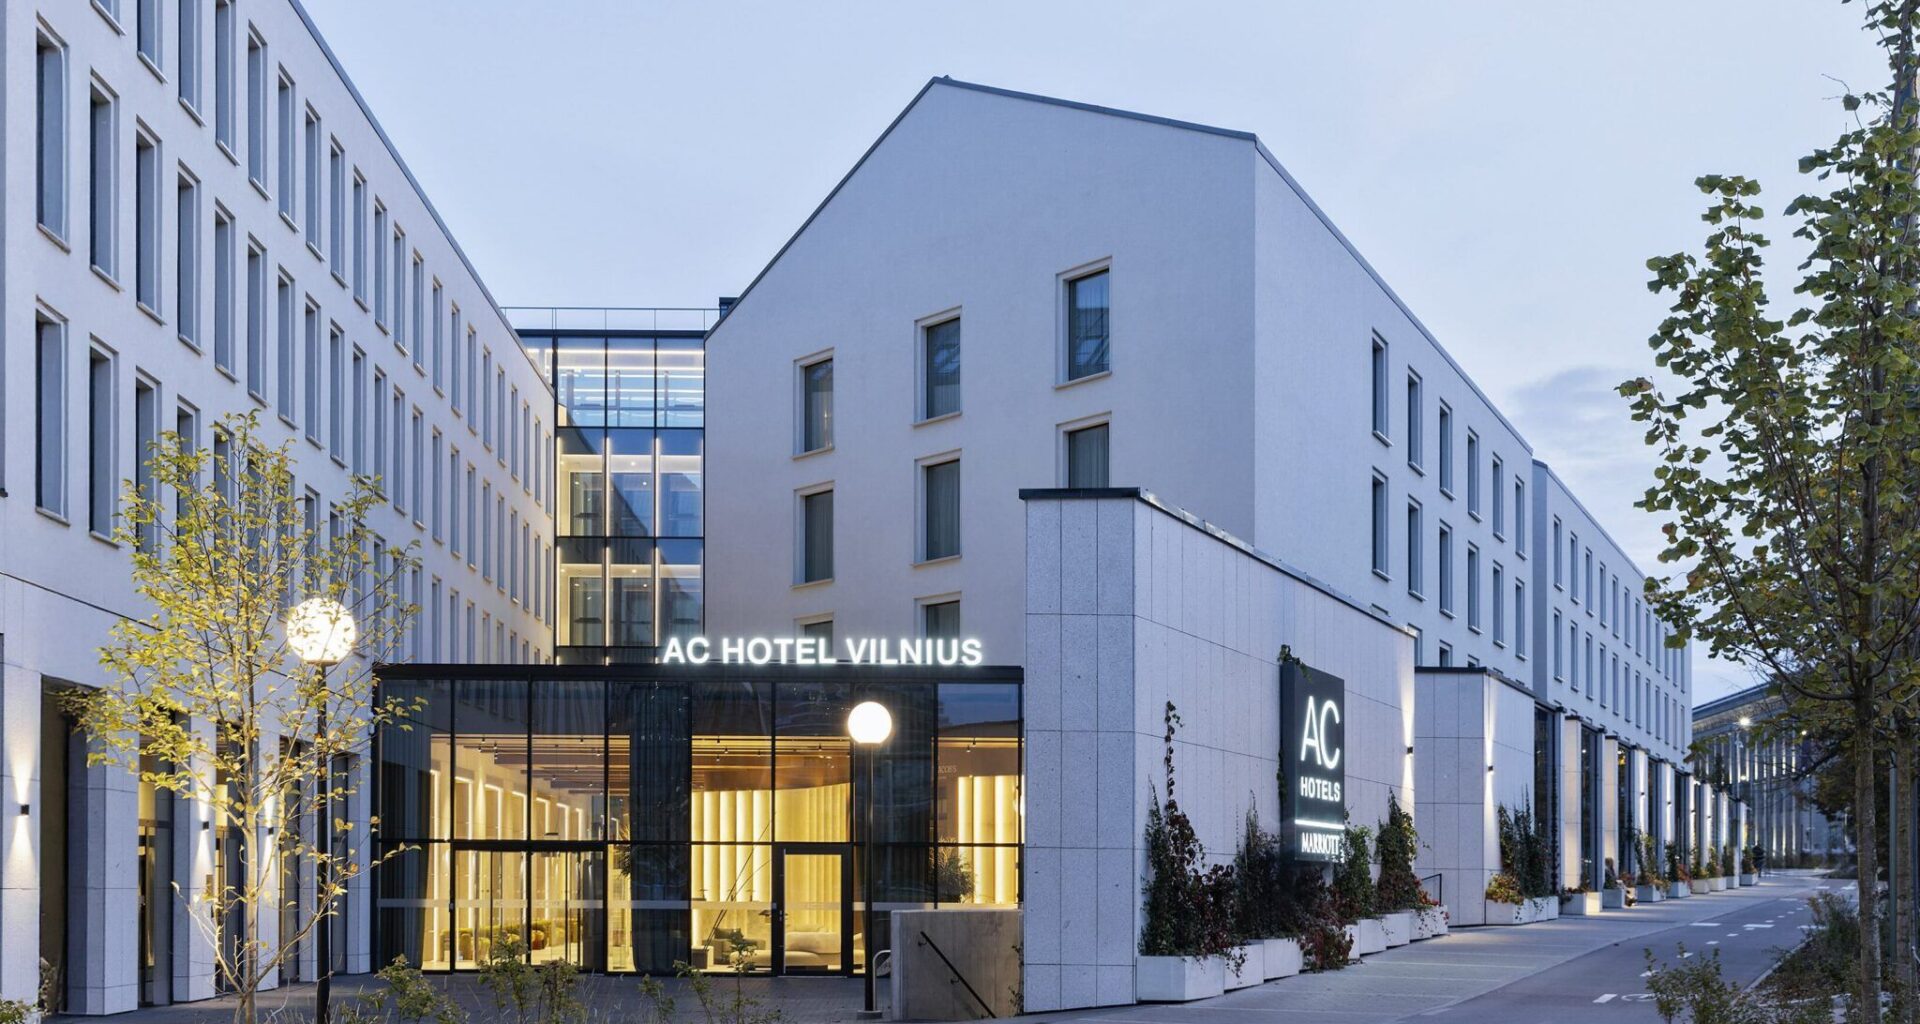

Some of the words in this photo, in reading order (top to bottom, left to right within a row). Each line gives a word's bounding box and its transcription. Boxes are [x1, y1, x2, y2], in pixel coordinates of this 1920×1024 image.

[663, 637, 710, 664] AC
[721, 637, 837, 664] HOTEL
[846, 637, 983, 665] VILNIUS
[1300, 695, 1340, 769] AC
[1300, 776, 1341, 802] HOTELS
[1301, 832, 1340, 855] MARRIOTT
